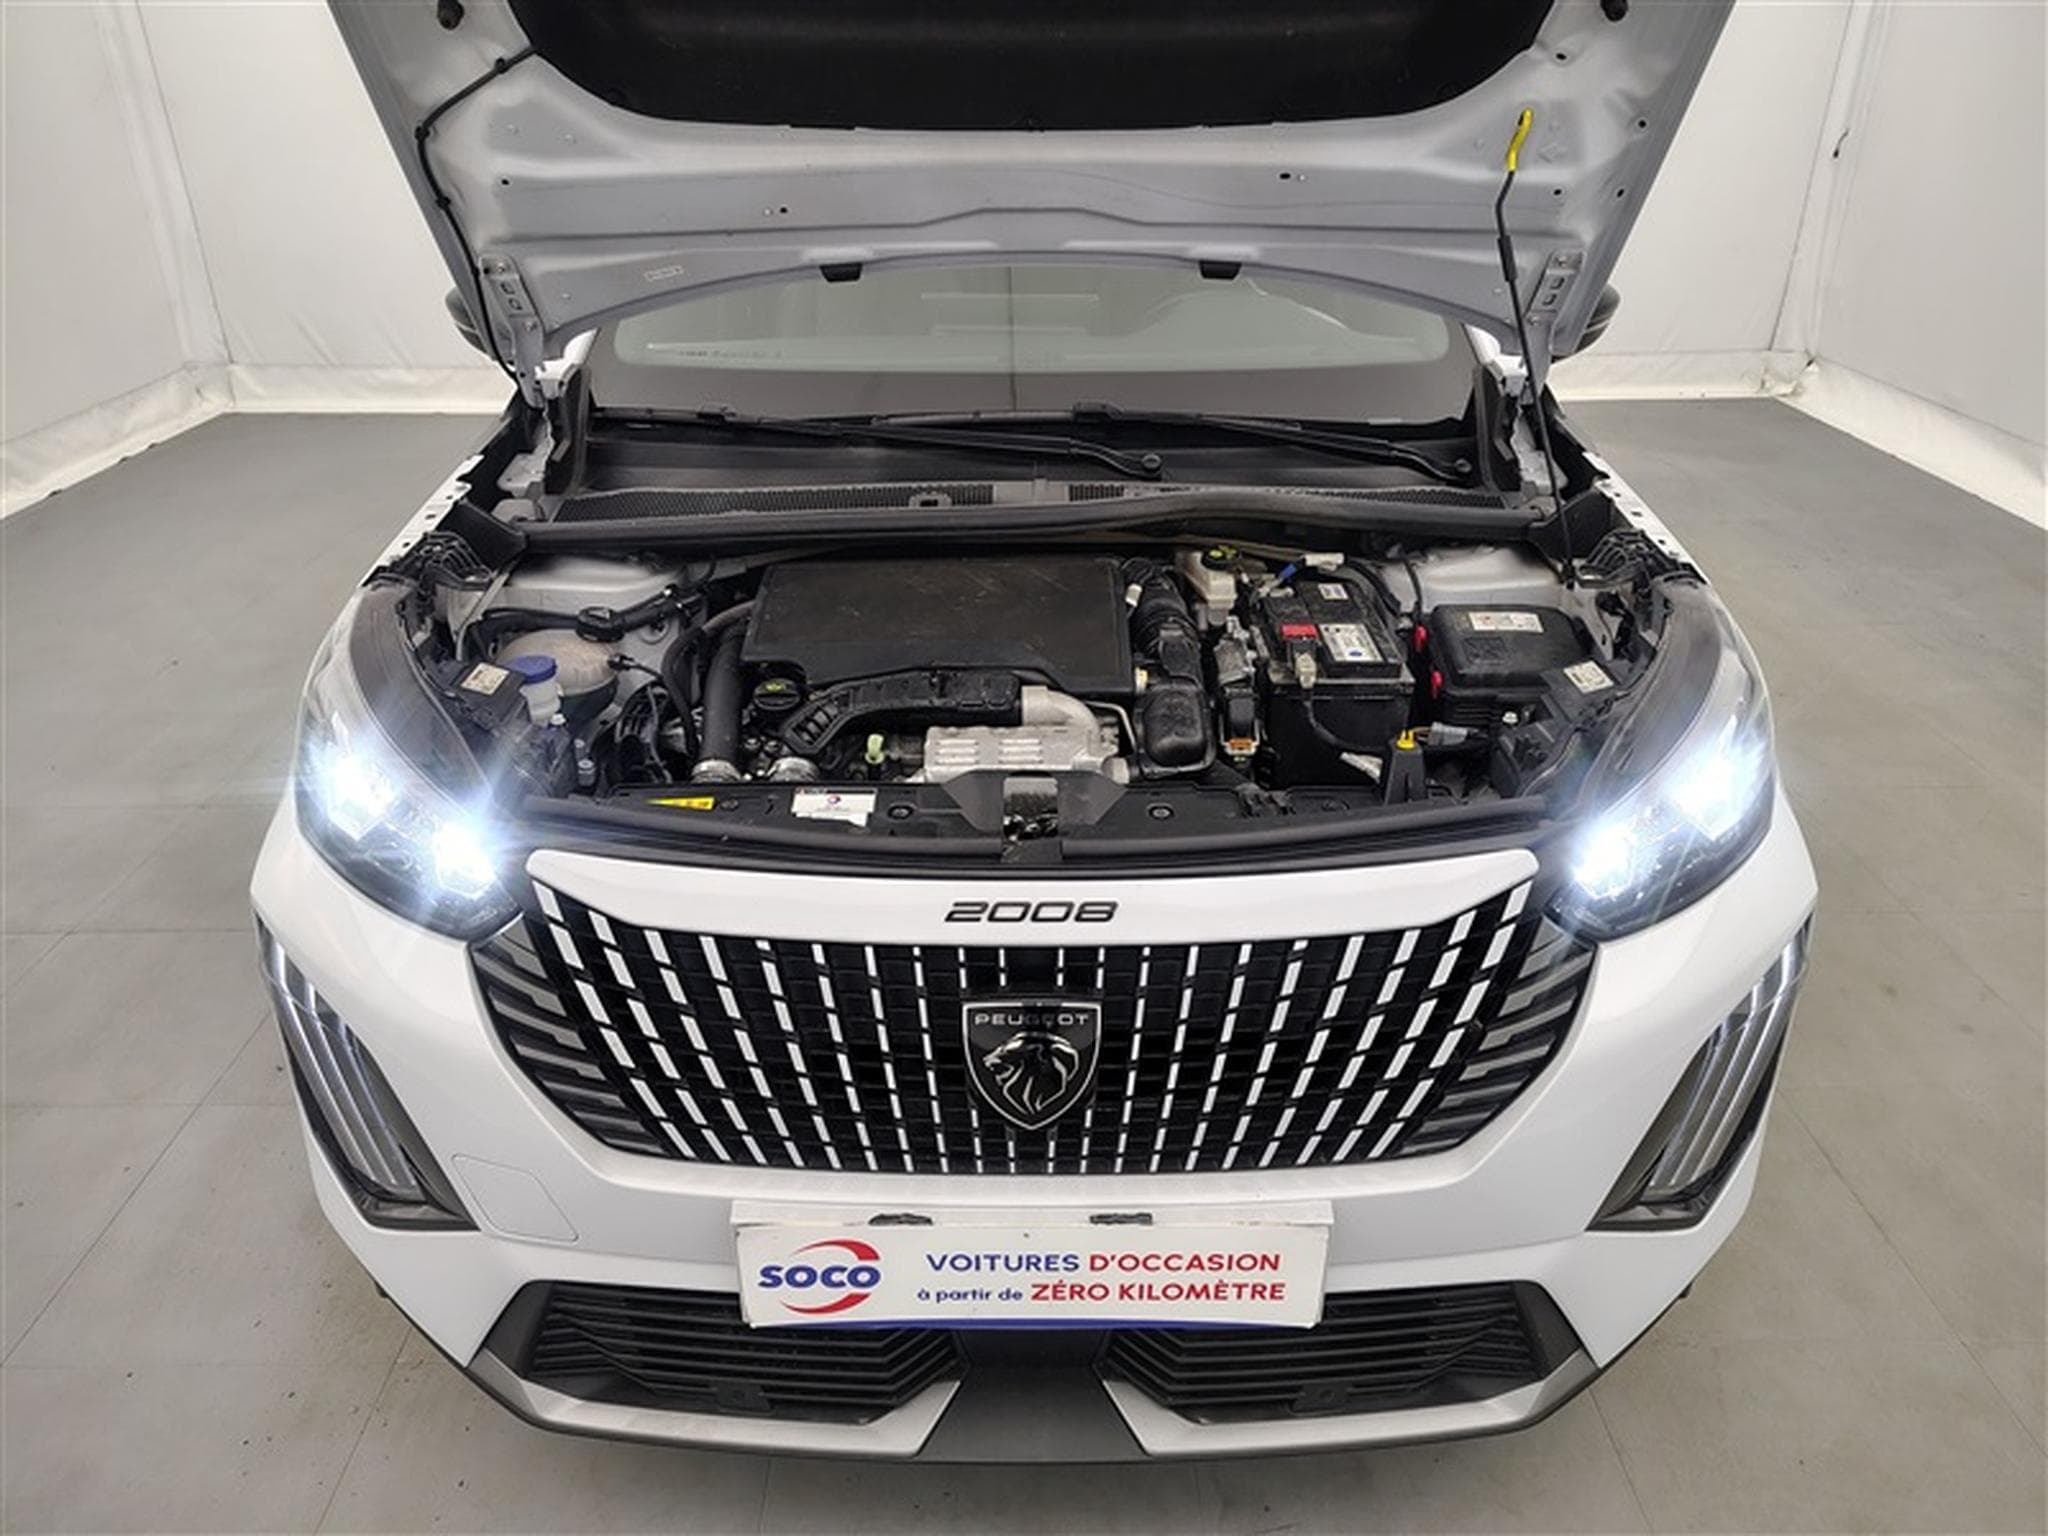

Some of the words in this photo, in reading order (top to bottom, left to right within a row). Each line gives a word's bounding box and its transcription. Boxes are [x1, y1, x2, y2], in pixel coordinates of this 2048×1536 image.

[944, 902, 1118, 923] 2008
[926, 1254, 1080, 1272] VOITURES
[1089, 1253, 1281, 1272] D'OCCASION
[758, 1265, 881, 1289] SOCO
[917, 1288, 930, 1301] à
[935, 1288, 992, 1304] partir
[998, 1288, 1023, 1301] de
[1031, 1279, 1110, 1301] ZÉRO
[1119, 1280, 1286, 1301] KILOMÈTRE
